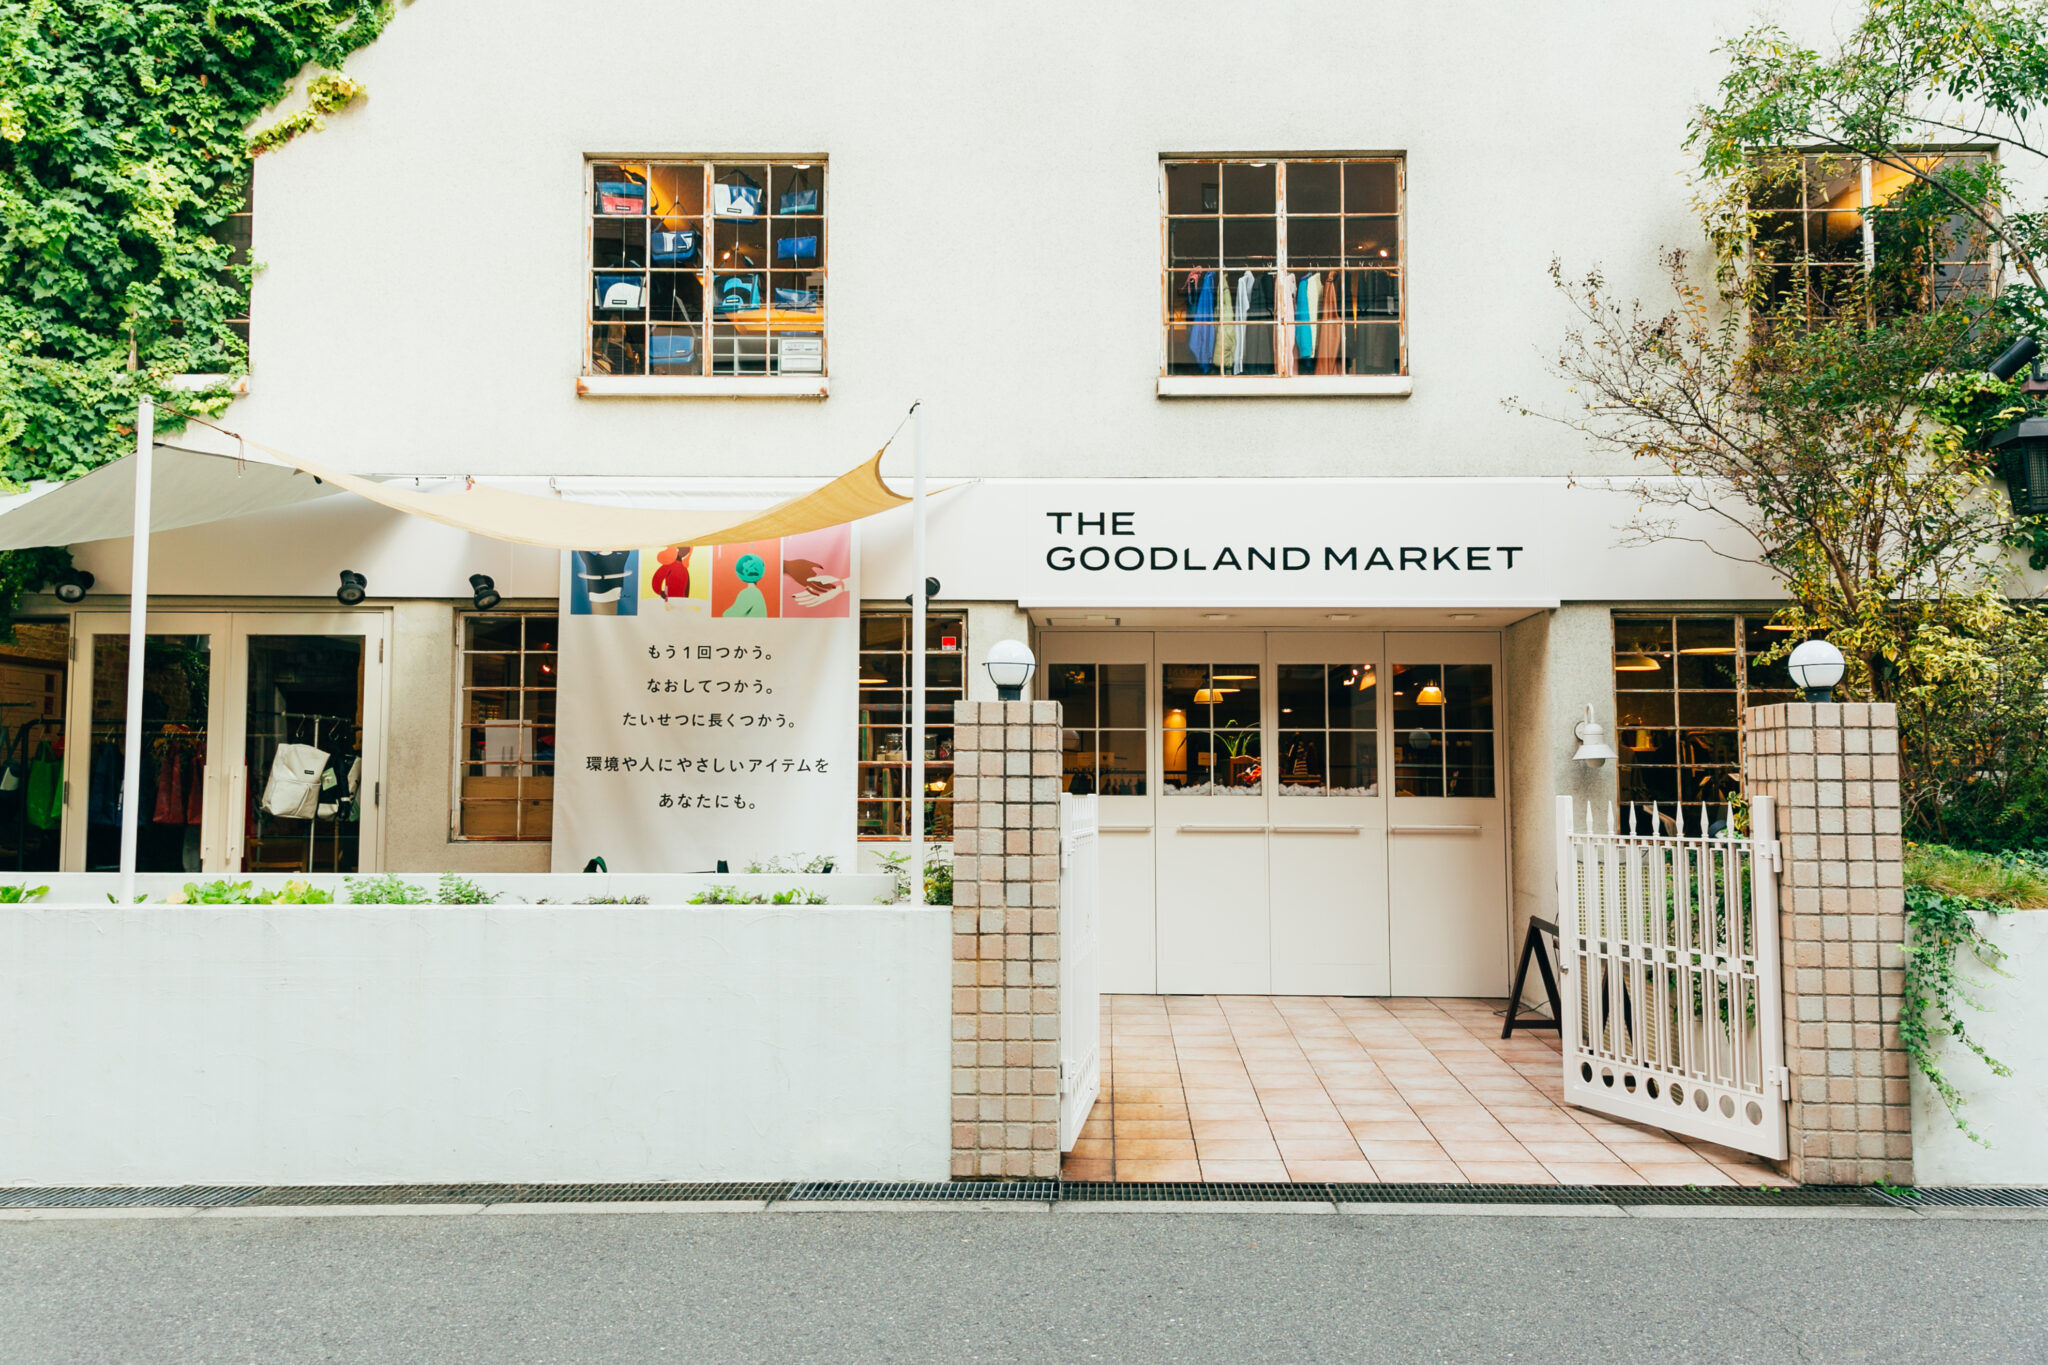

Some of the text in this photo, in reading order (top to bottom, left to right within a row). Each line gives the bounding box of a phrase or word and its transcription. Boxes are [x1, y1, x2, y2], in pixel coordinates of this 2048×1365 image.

[1046, 511, 1136, 536] THE
[1046, 546, 1524, 572] GOODLAND MARKET
[648, 644, 773, 661] もう1回つかう。
[647, 678, 773, 695] なおしてつかう。
[622, 712, 795, 728] たいせつに長くつかう。
[585, 755, 829, 773] 環境や人にやさしいアイテムを
[658, 793, 757, 810] あなたにも。
